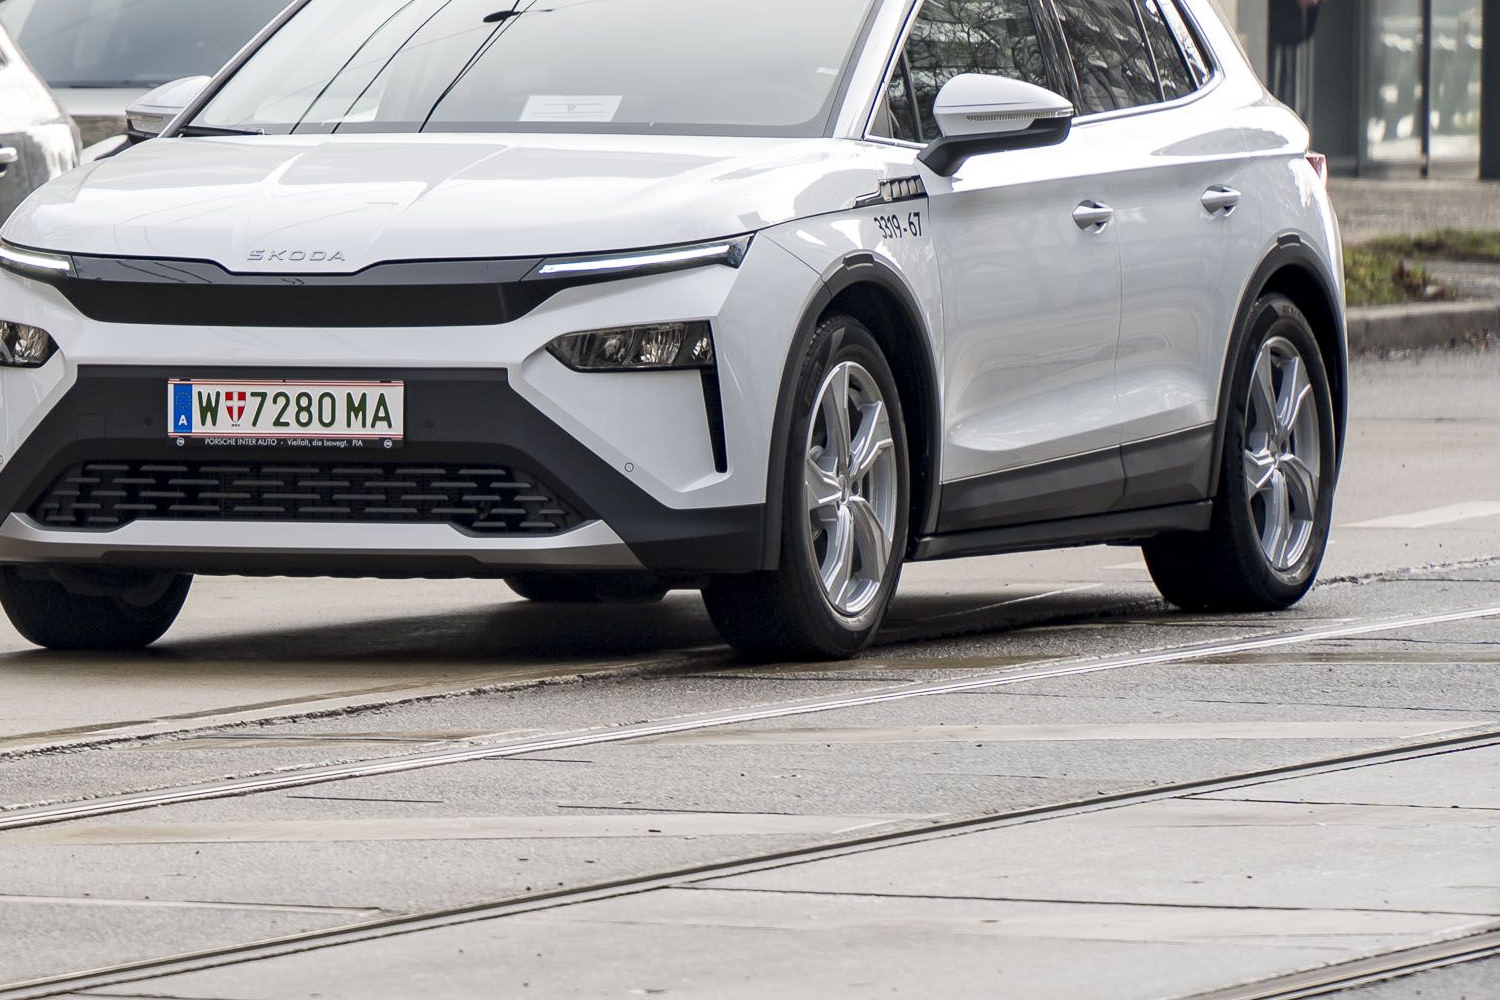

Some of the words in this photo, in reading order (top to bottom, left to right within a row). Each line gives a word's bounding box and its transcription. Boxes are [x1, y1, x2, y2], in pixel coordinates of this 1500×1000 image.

[874, 211, 922, 239] 3319-67
[197, 390, 221, 427] W
[249, 391, 337, 428] 7280
[346, 391, 393, 429] MA
[177, 414, 188, 427] A
[205, 437, 236, 446] PORSCHE
[237, 438, 257, 446] INTER
[257, 438, 277, 446] AUTO
[287, 438, 311, 447] Vielfalt,
[323, 439, 349, 448] bewegt.
[352, 439, 363, 447] PIA
